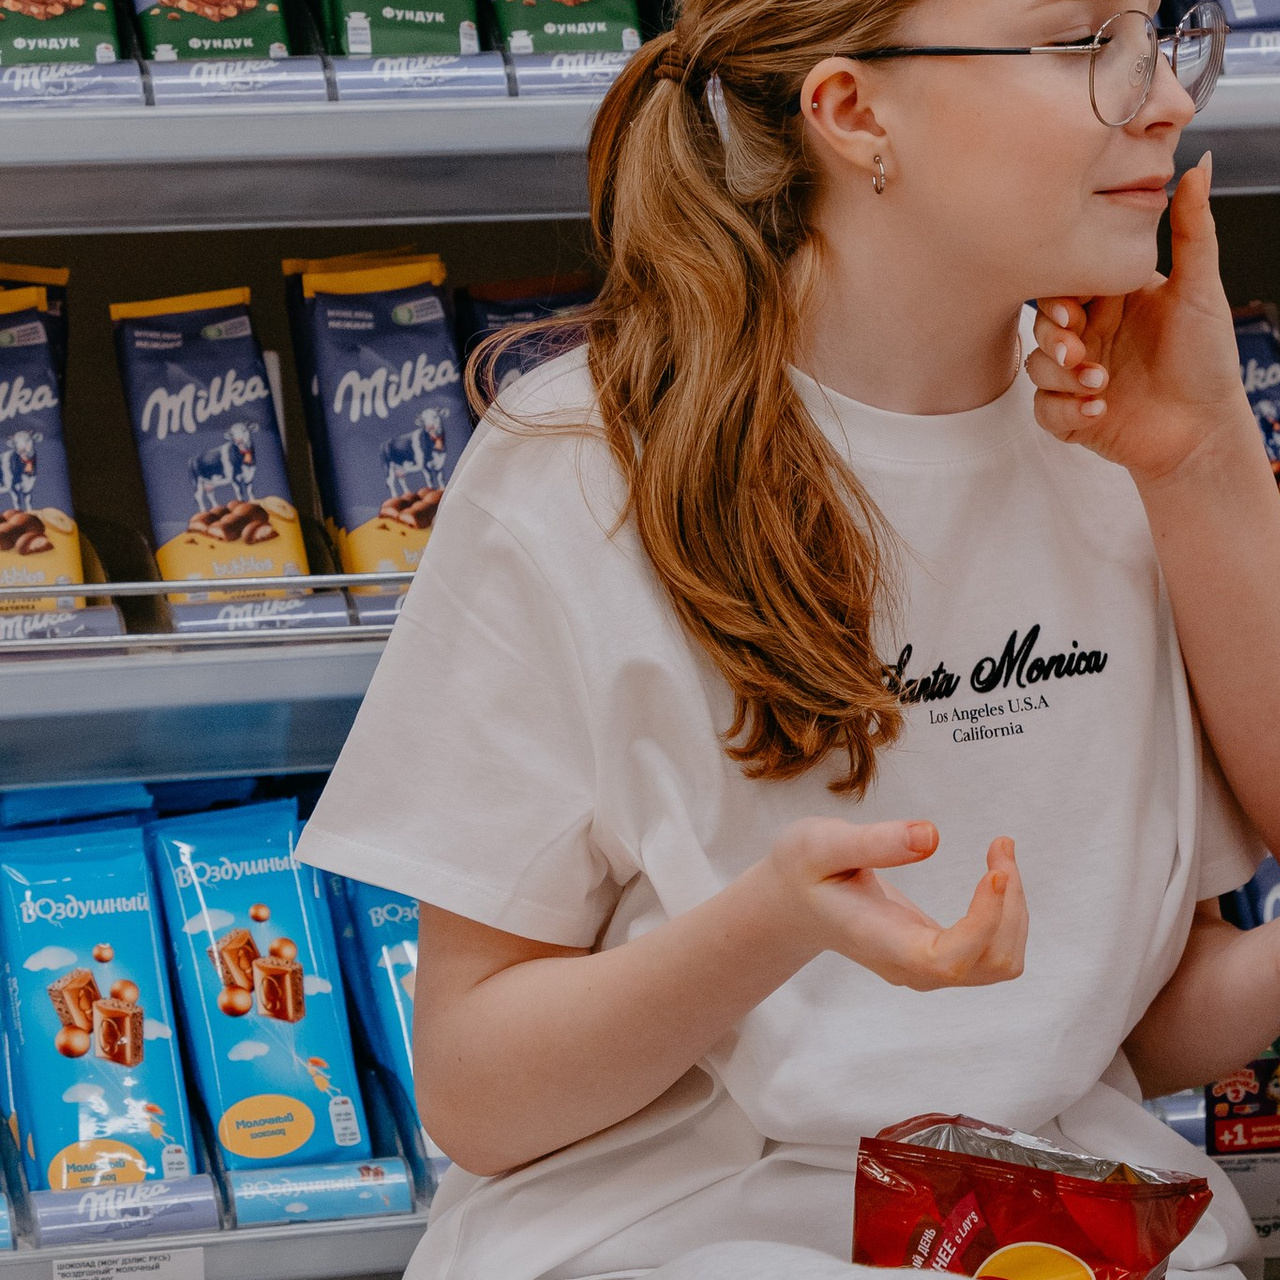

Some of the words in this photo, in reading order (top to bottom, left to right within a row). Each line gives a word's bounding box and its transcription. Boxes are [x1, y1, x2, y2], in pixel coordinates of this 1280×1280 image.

[3, 64, 94, 92] Milka
[190, 60, 280, 86] Milka
[333, 355, 460, 422] Milka
[140, 370, 270, 440] Milka
[970, 623, 1108, 693] Monica
[930, 708, 949, 725] Los
[951, 703, 1004, 723] Angeles
[1007, 695, 1049, 714] U.S.A
[952, 722, 1023, 743] California
[235, 1114, 295, 1133] Молочный
[1219, 1123, 1249, 1146] +1
[78, 1182, 171, 1220] Milka
[917, 1227, 937, 1258] ДЕНЬ
[57, 1261, 96, 1271] ШОКОЛАД
